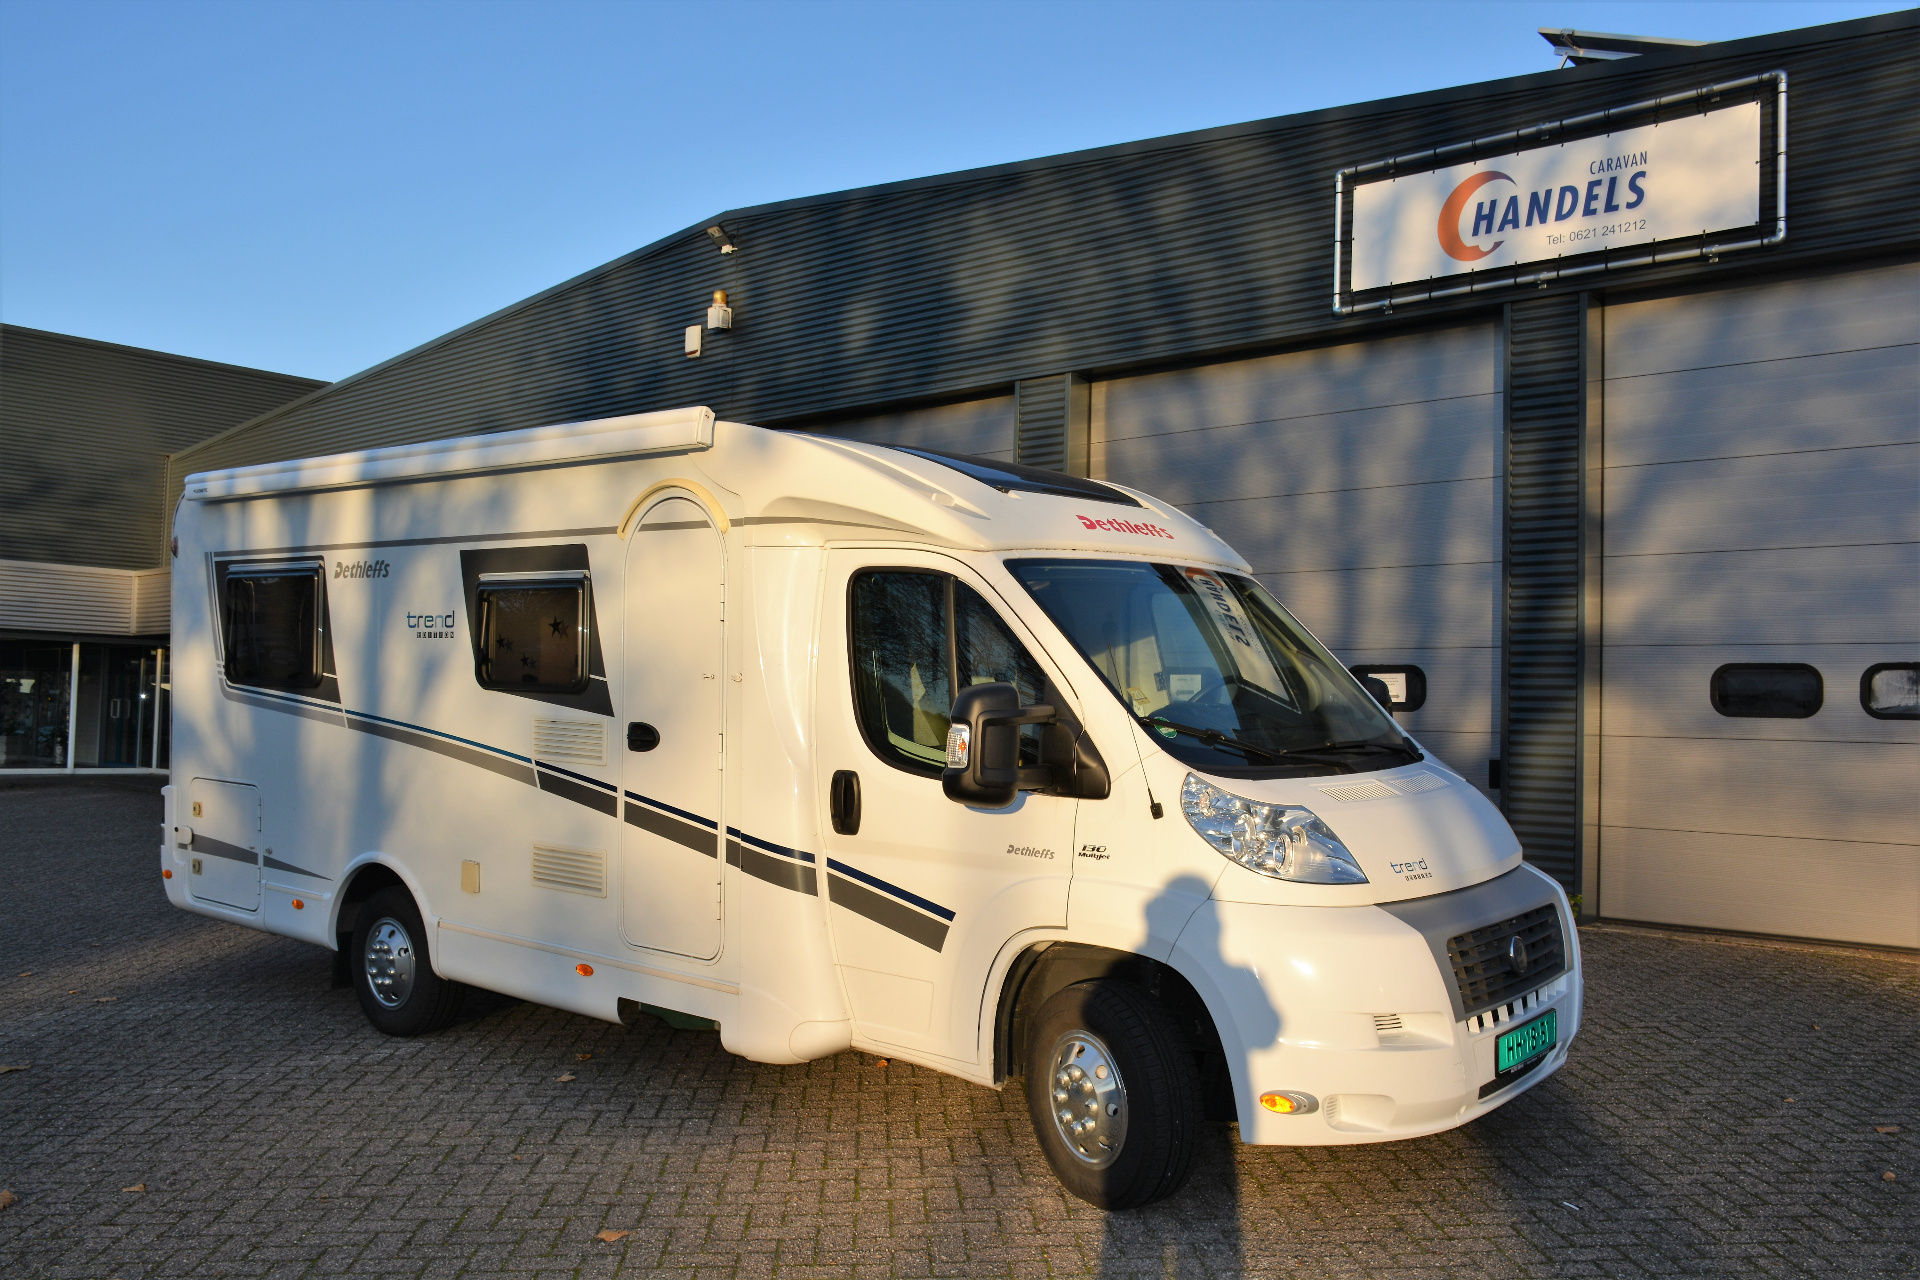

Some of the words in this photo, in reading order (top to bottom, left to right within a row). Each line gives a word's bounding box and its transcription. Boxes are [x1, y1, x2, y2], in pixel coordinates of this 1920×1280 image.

[1589, 150, 1648, 175] CARAVAN
[1546, 233, 1566, 246] Tel:
[1569, 227, 1598, 242] 0621
[1601, 219, 1647, 237] 241212
[1075, 514, 1175, 540] Dethleffs
[334, 559, 390, 579] Dethleffs
[406, 609, 455, 629] trend
[1006, 844, 1056, 860] Dethleffs
[1081, 844, 1107, 853] 130
[1389, 857, 1428, 874] trend
